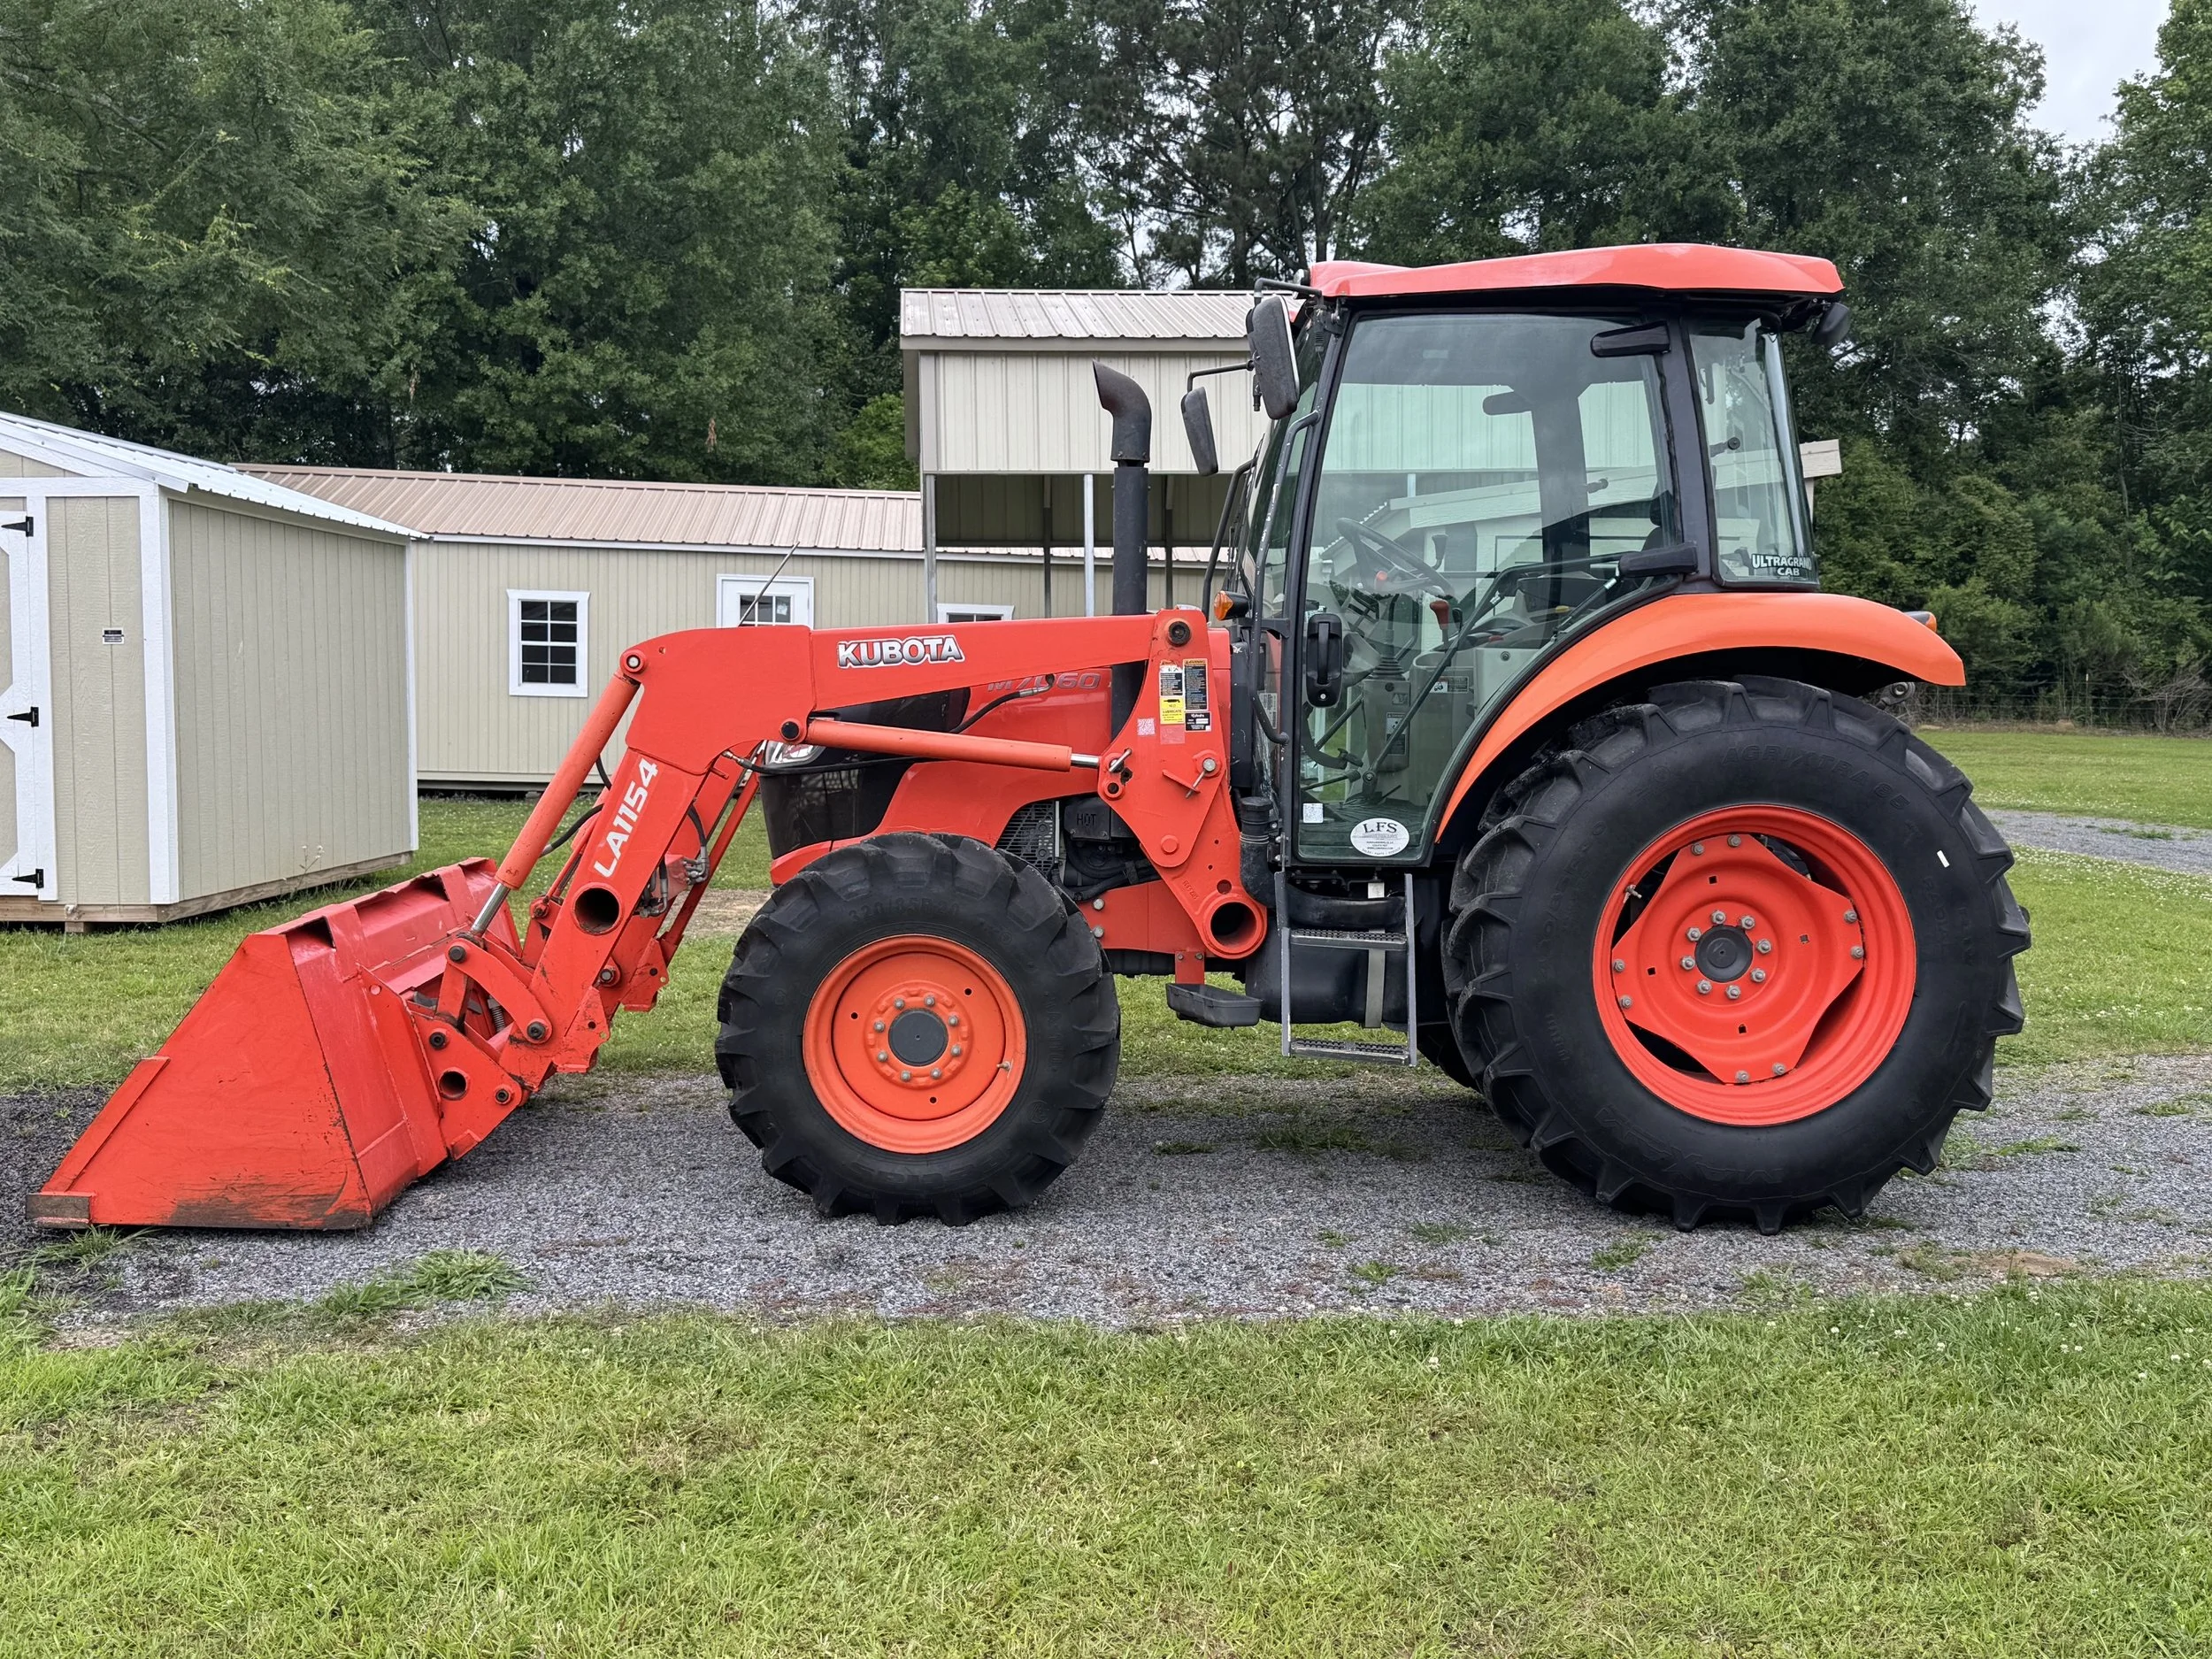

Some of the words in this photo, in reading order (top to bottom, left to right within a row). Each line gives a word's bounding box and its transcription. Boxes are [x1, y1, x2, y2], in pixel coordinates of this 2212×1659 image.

[1752, 554, 1812, 570] ULTRAGRAND
[1777, 567, 1800, 576] CAB
[838, 635, 964, 668] KUBOTA
[594, 758, 659, 878] LA1154
[1077, 814, 1097, 826] HOT
[1363, 822, 1397, 833] LFS
